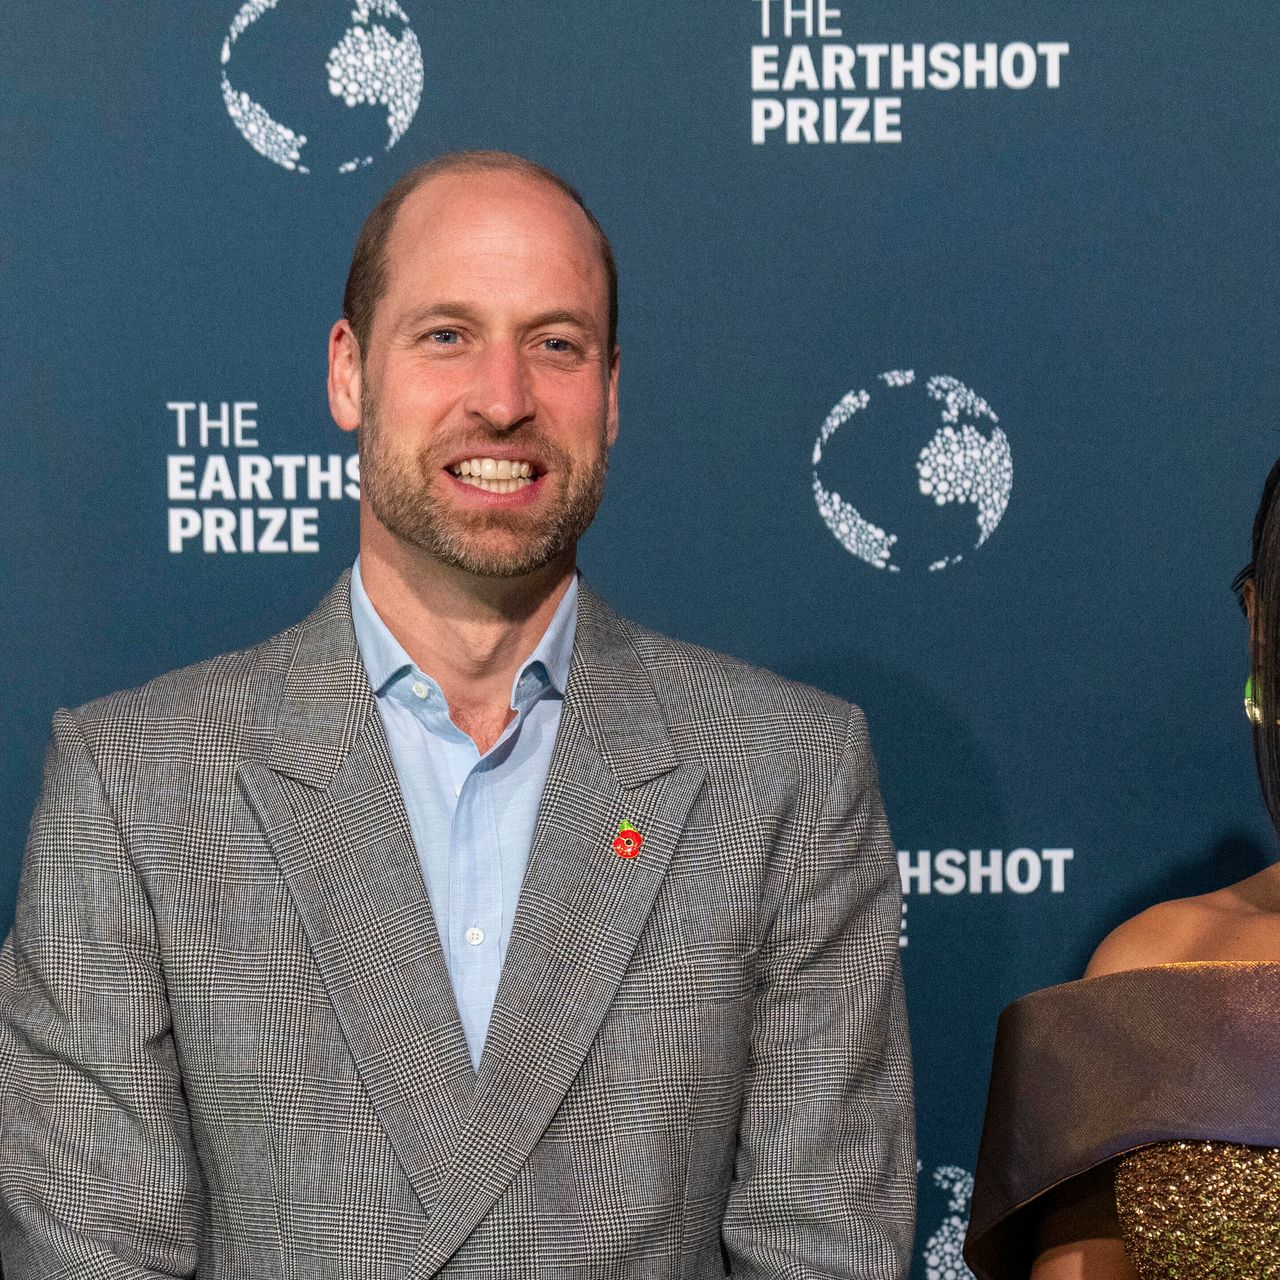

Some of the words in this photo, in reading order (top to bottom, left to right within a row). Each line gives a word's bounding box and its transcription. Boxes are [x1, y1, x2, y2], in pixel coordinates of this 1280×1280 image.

[754, 0, 842, 37] THE
[751, 42, 1069, 90] EARTHSHOT
[752, 97, 902, 144] PRIZE
[167, 402, 258, 447] THE
[167, 454, 360, 500] EARTH
[168, 508, 319, 553] PRIZE
